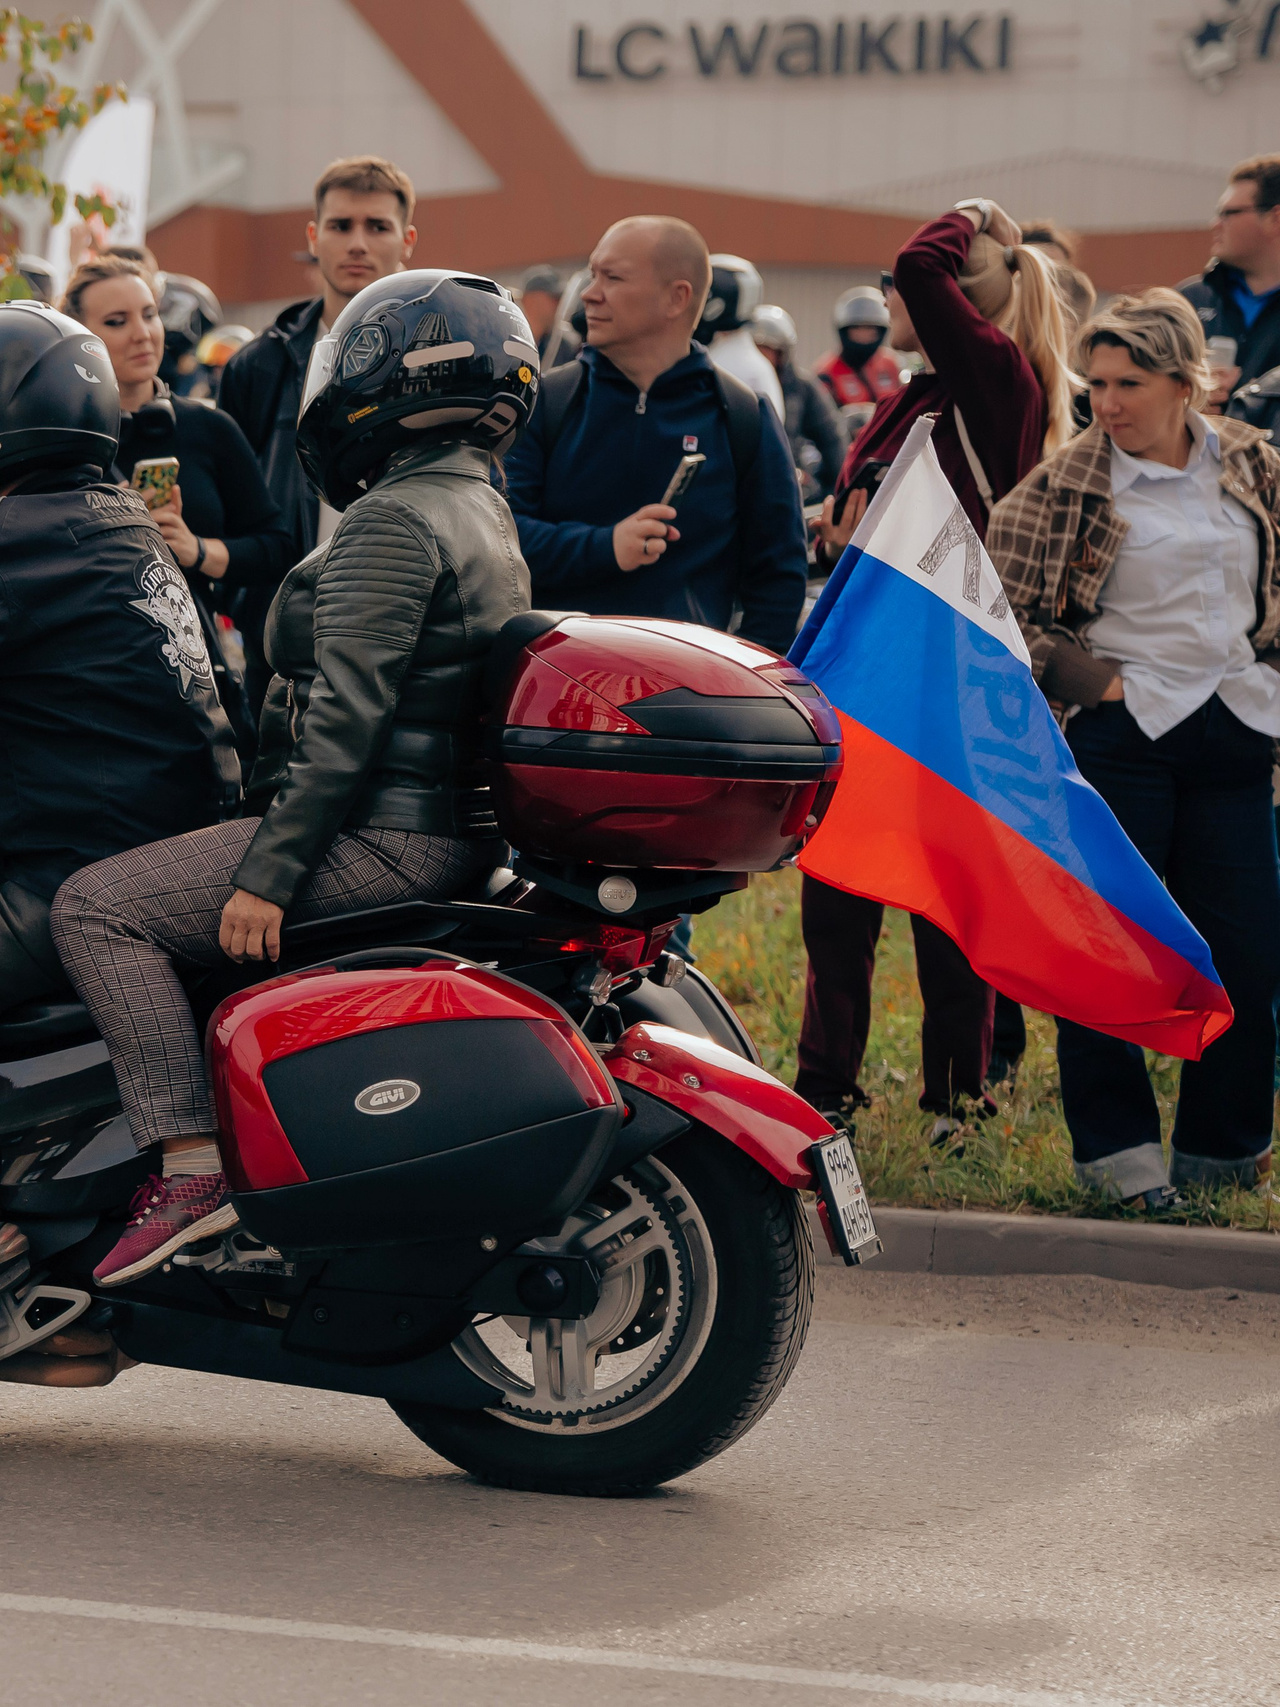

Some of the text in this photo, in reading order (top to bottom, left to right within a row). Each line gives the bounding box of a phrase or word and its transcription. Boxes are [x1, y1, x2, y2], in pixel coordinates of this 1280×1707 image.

[576, 23, 667, 82] LC
[144, 567, 166, 591] LIVE
[179, 650, 201, 673] RIDE
[369, 1087, 406, 1107] GIVI
[826, 1142, 854, 1185] 9946
